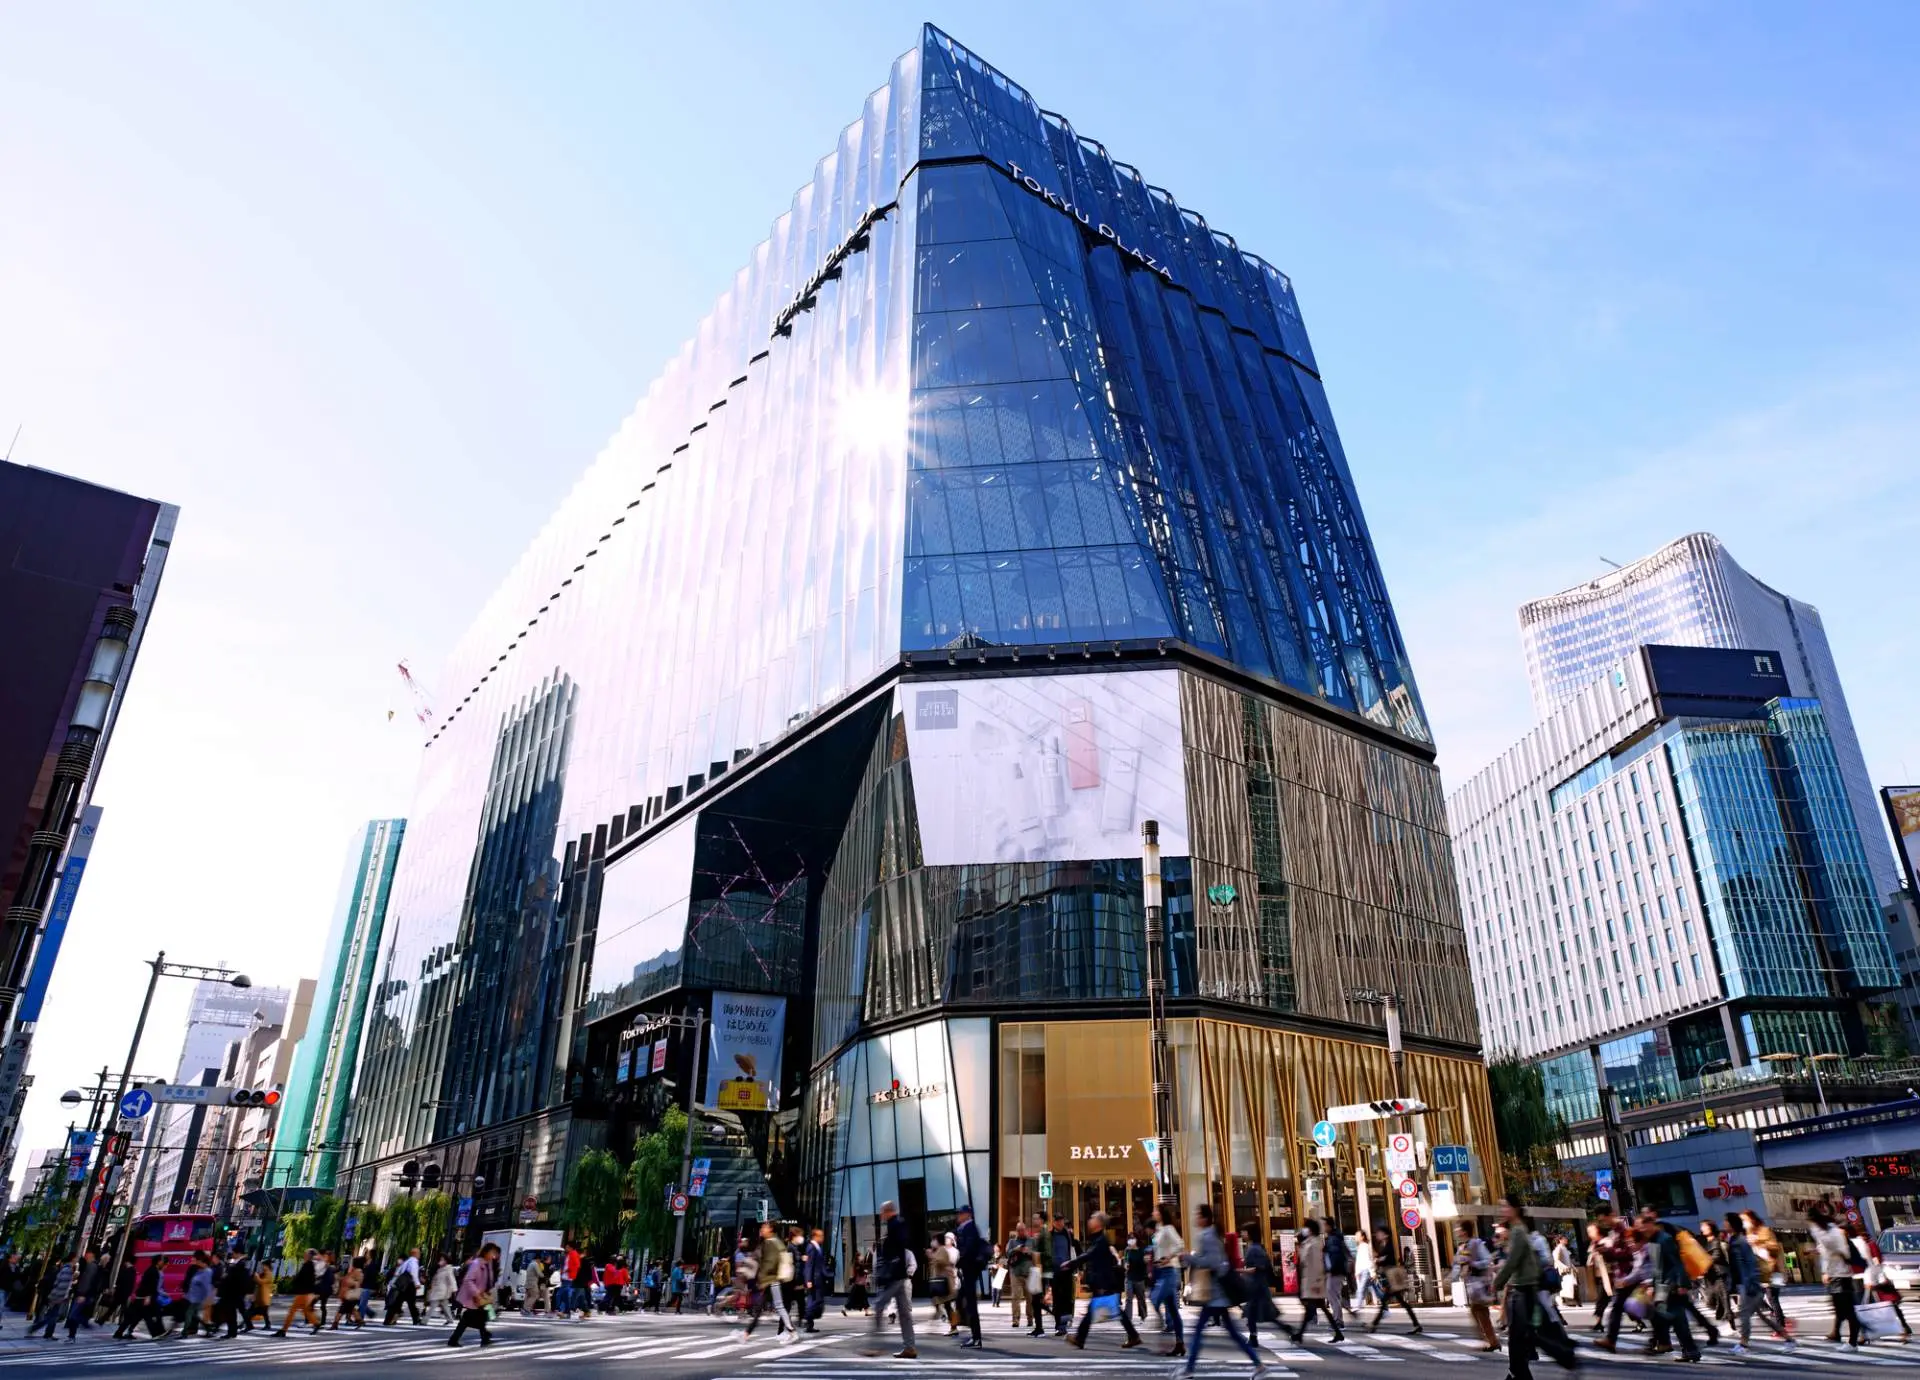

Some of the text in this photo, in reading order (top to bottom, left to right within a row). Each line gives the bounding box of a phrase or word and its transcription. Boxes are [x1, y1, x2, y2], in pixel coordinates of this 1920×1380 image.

[1007, 160, 1172, 281] TOKYU PLAZA
[723, 1003, 777, 1018] 海外旅行の
[1070, 1145, 1132, 1159] BALLY
